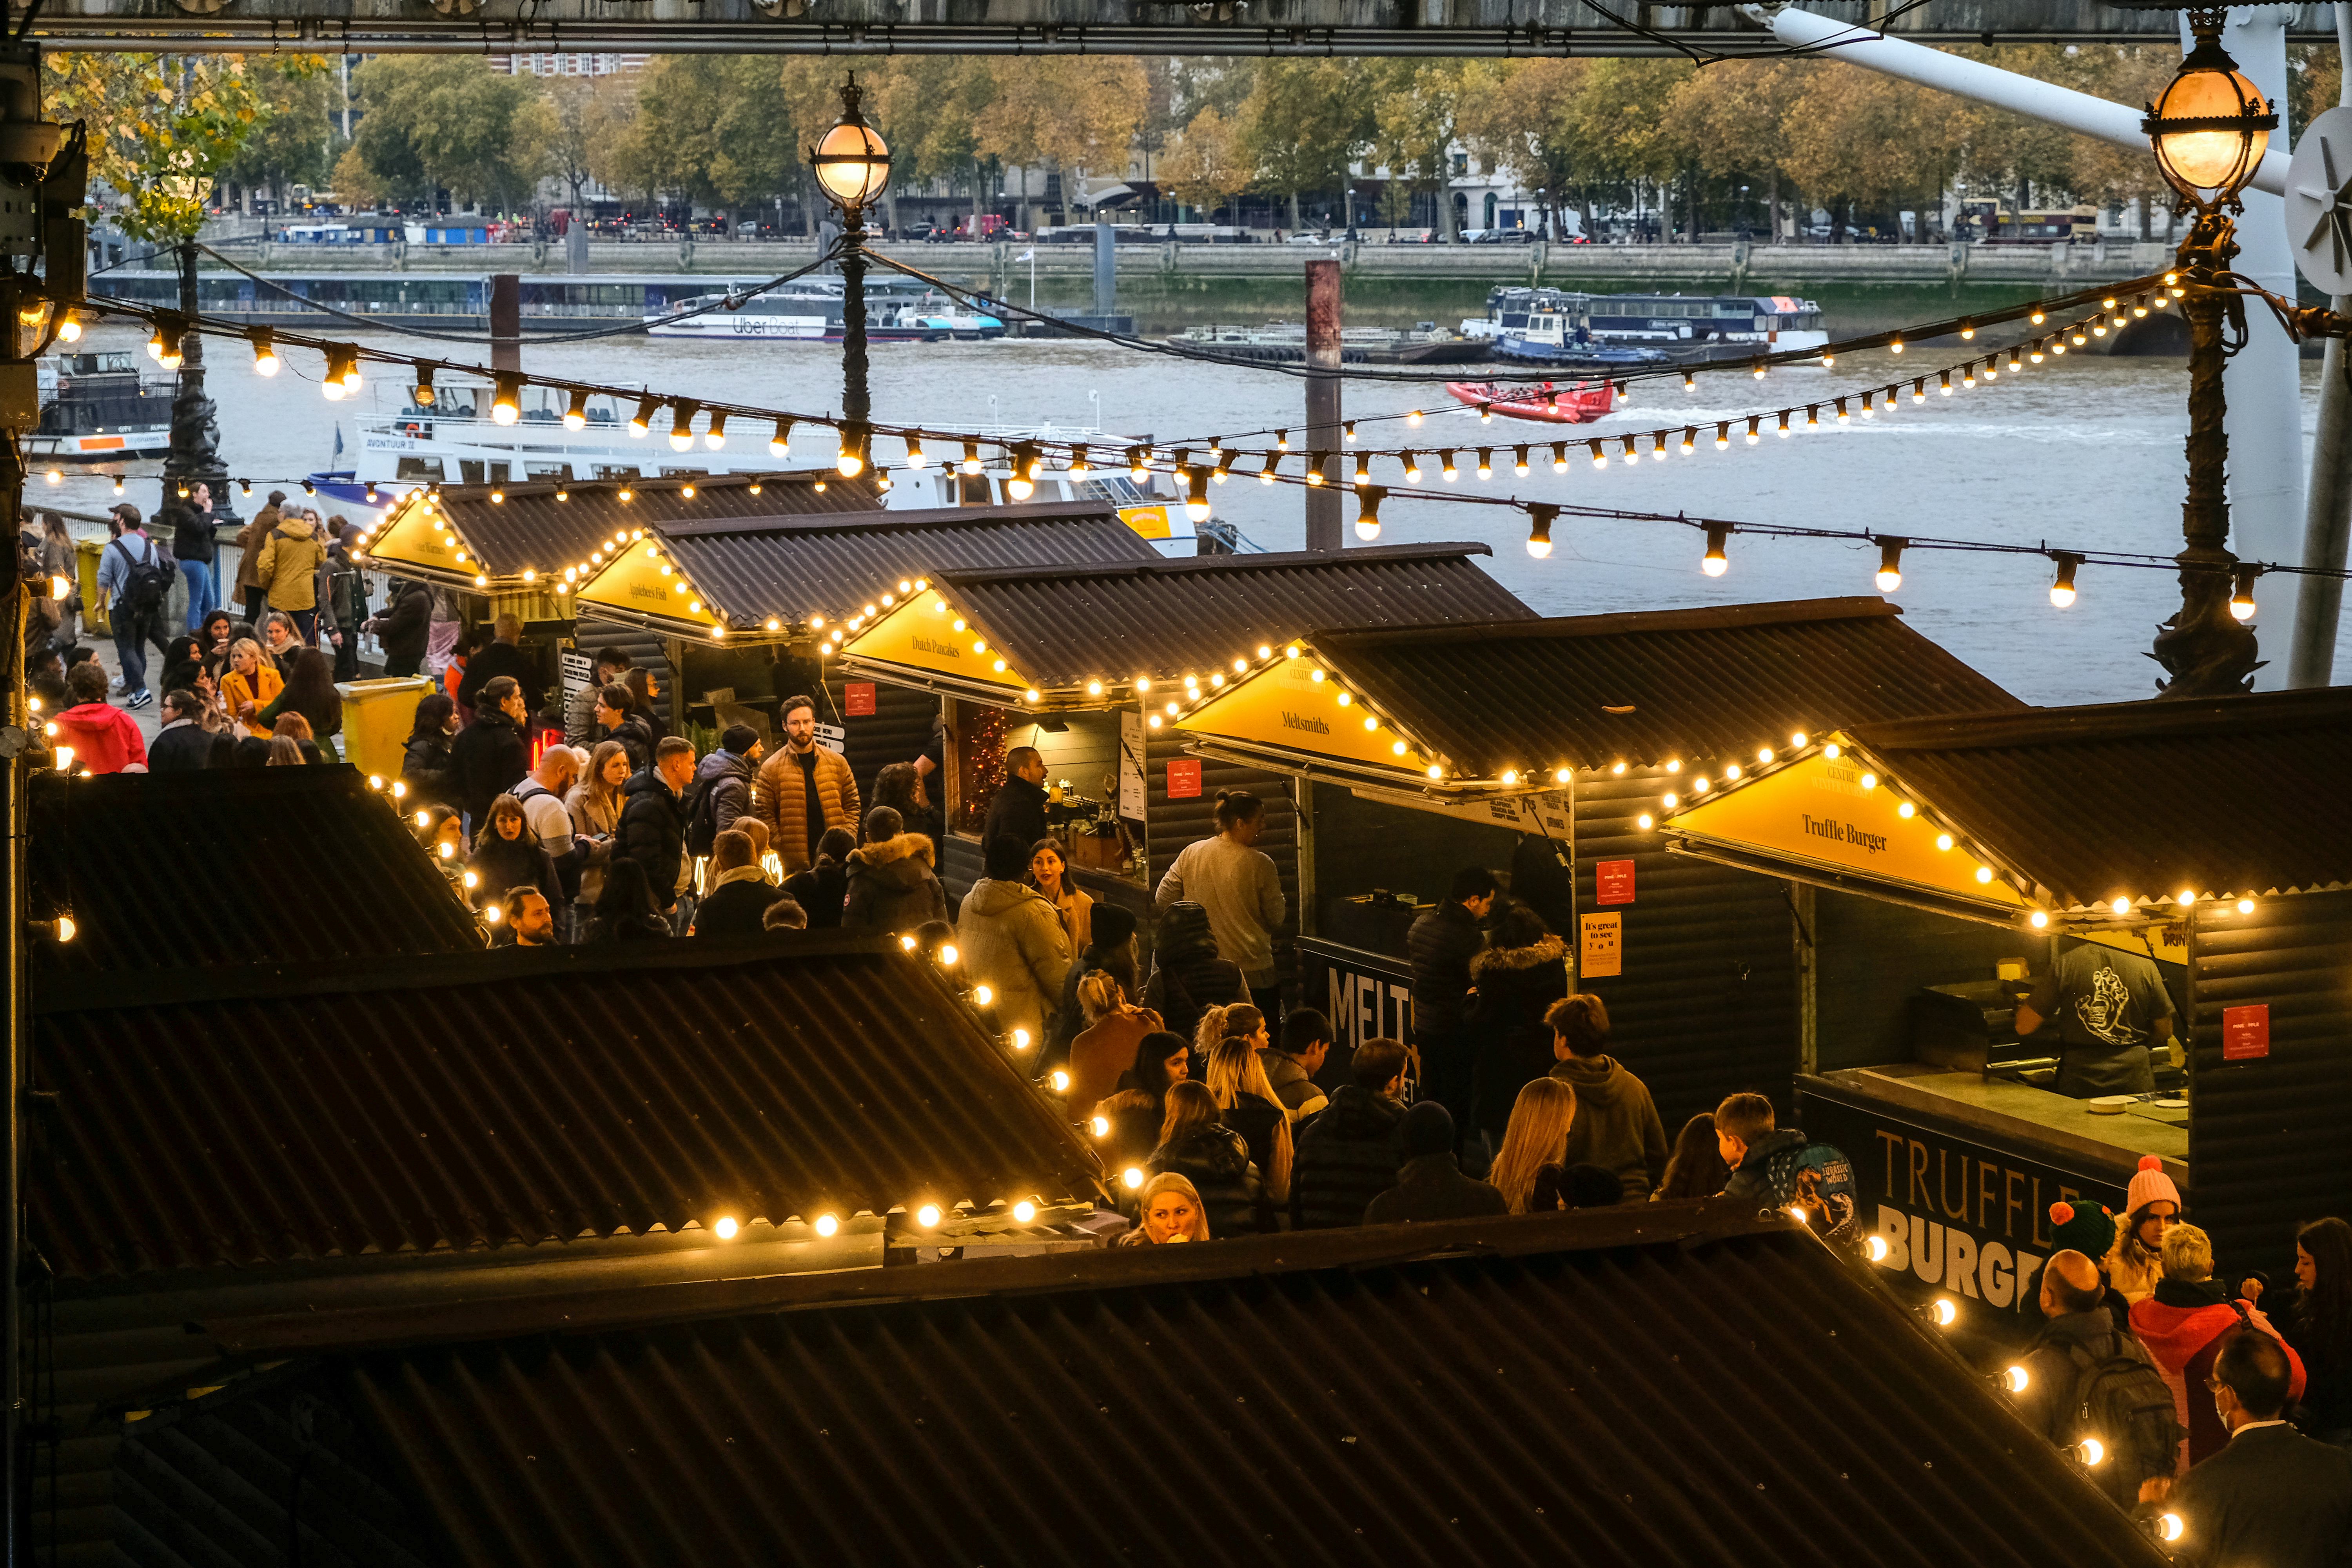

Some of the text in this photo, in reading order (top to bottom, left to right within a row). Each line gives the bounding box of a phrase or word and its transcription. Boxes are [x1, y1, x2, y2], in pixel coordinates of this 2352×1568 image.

[733, 316, 800, 334] Uber Boat
[367, 439, 405, 449] AVONTUUR
[655, 587, 667, 601] Fish
[912, 635, 960, 659] Dutch Pancakes
[1281, 711, 1329, 735] Meltsmiths
[1828, 766, 1856, 783] CENTRE
[1802, 814, 1887, 855] Truffle Burger
[1598, 922, 1617, 931] great
[2162, 933, 2187, 947] DRIN
[1329, 967, 1416, 1058] MELT
[1822, 1164, 1848, 1176] JURASSIC
[1826, 1173, 1848, 1185] WORLD
